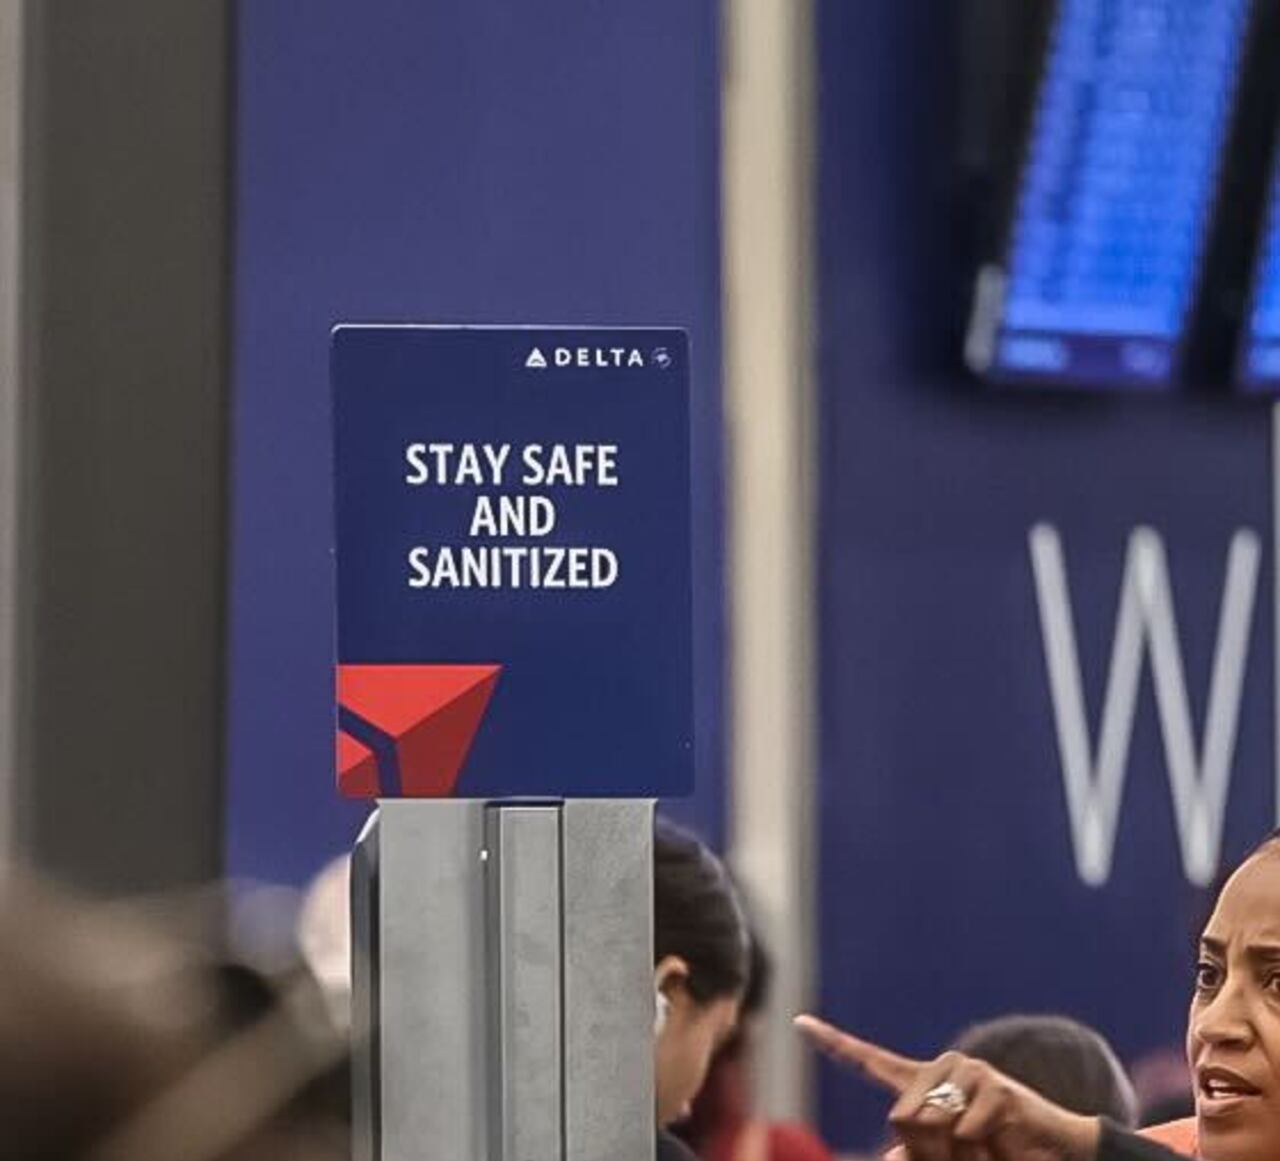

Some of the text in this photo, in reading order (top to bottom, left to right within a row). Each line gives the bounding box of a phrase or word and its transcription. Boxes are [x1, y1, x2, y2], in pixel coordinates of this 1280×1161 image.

[554, 347, 644, 367] DELTA
[405, 443, 619, 486] STAY SAFE
[469, 495, 556, 537] AND
[408, 546, 619, 589] SANITIZED
